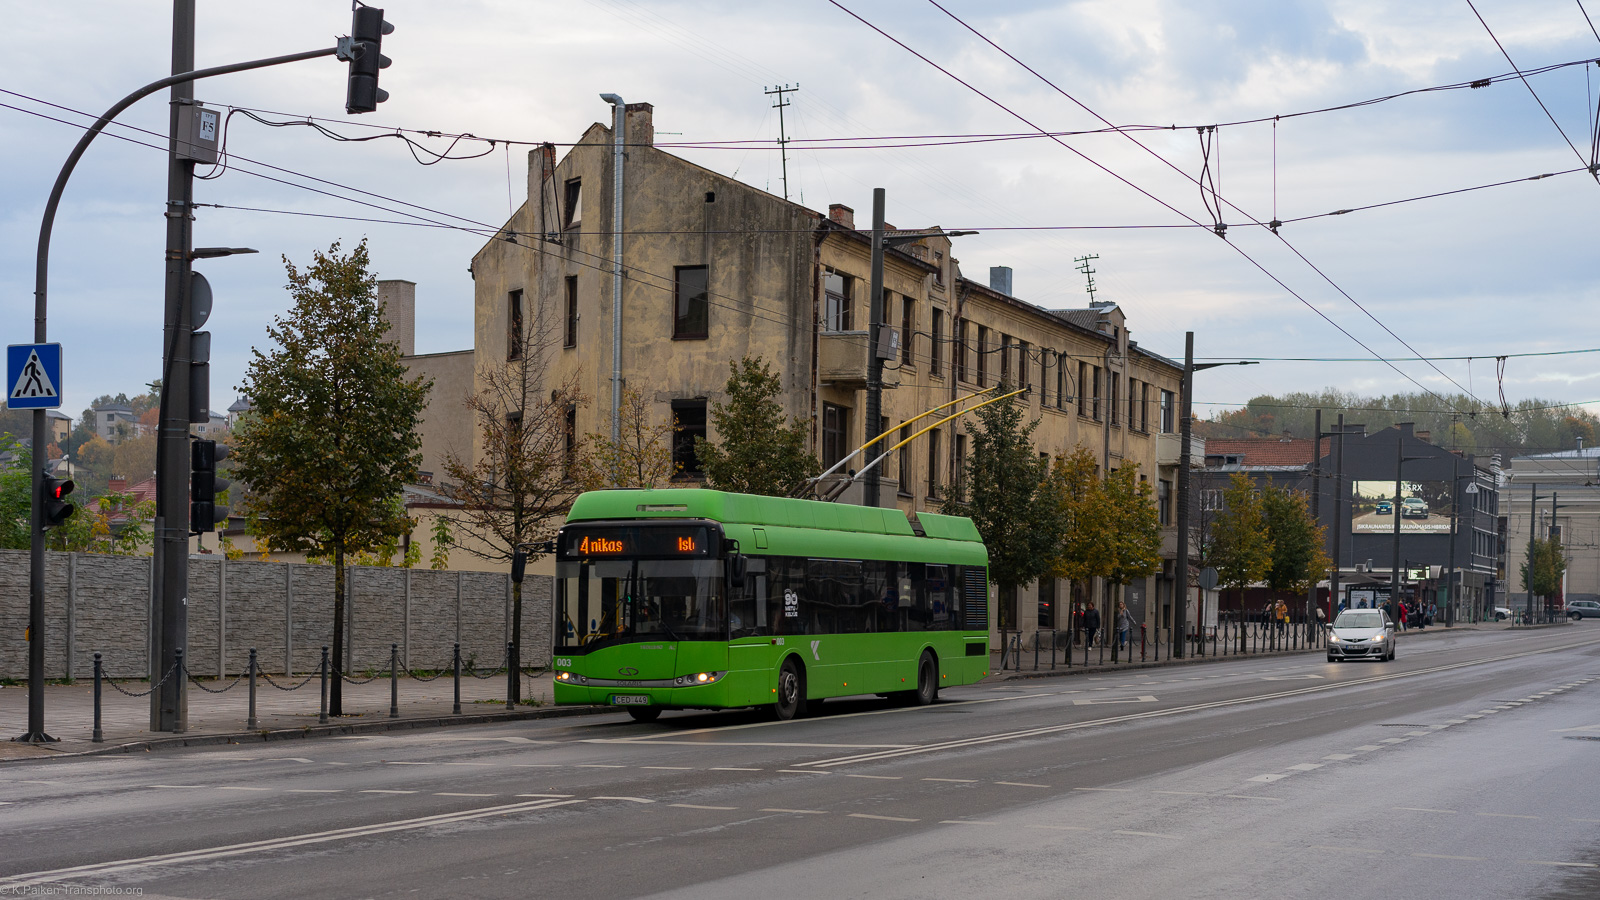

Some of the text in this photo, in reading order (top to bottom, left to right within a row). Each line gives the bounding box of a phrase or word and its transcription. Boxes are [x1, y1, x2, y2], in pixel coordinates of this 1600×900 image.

[202, 120, 214, 132] F5
[1412, 484, 1423, 492] RX
[580, 536, 695, 554] 4 nikas Isl
[785, 593, 798, 605] 90
[776, 637, 784, 645] 003
[557, 658, 572, 667] 003
[616, 696, 647, 704] CED 449
